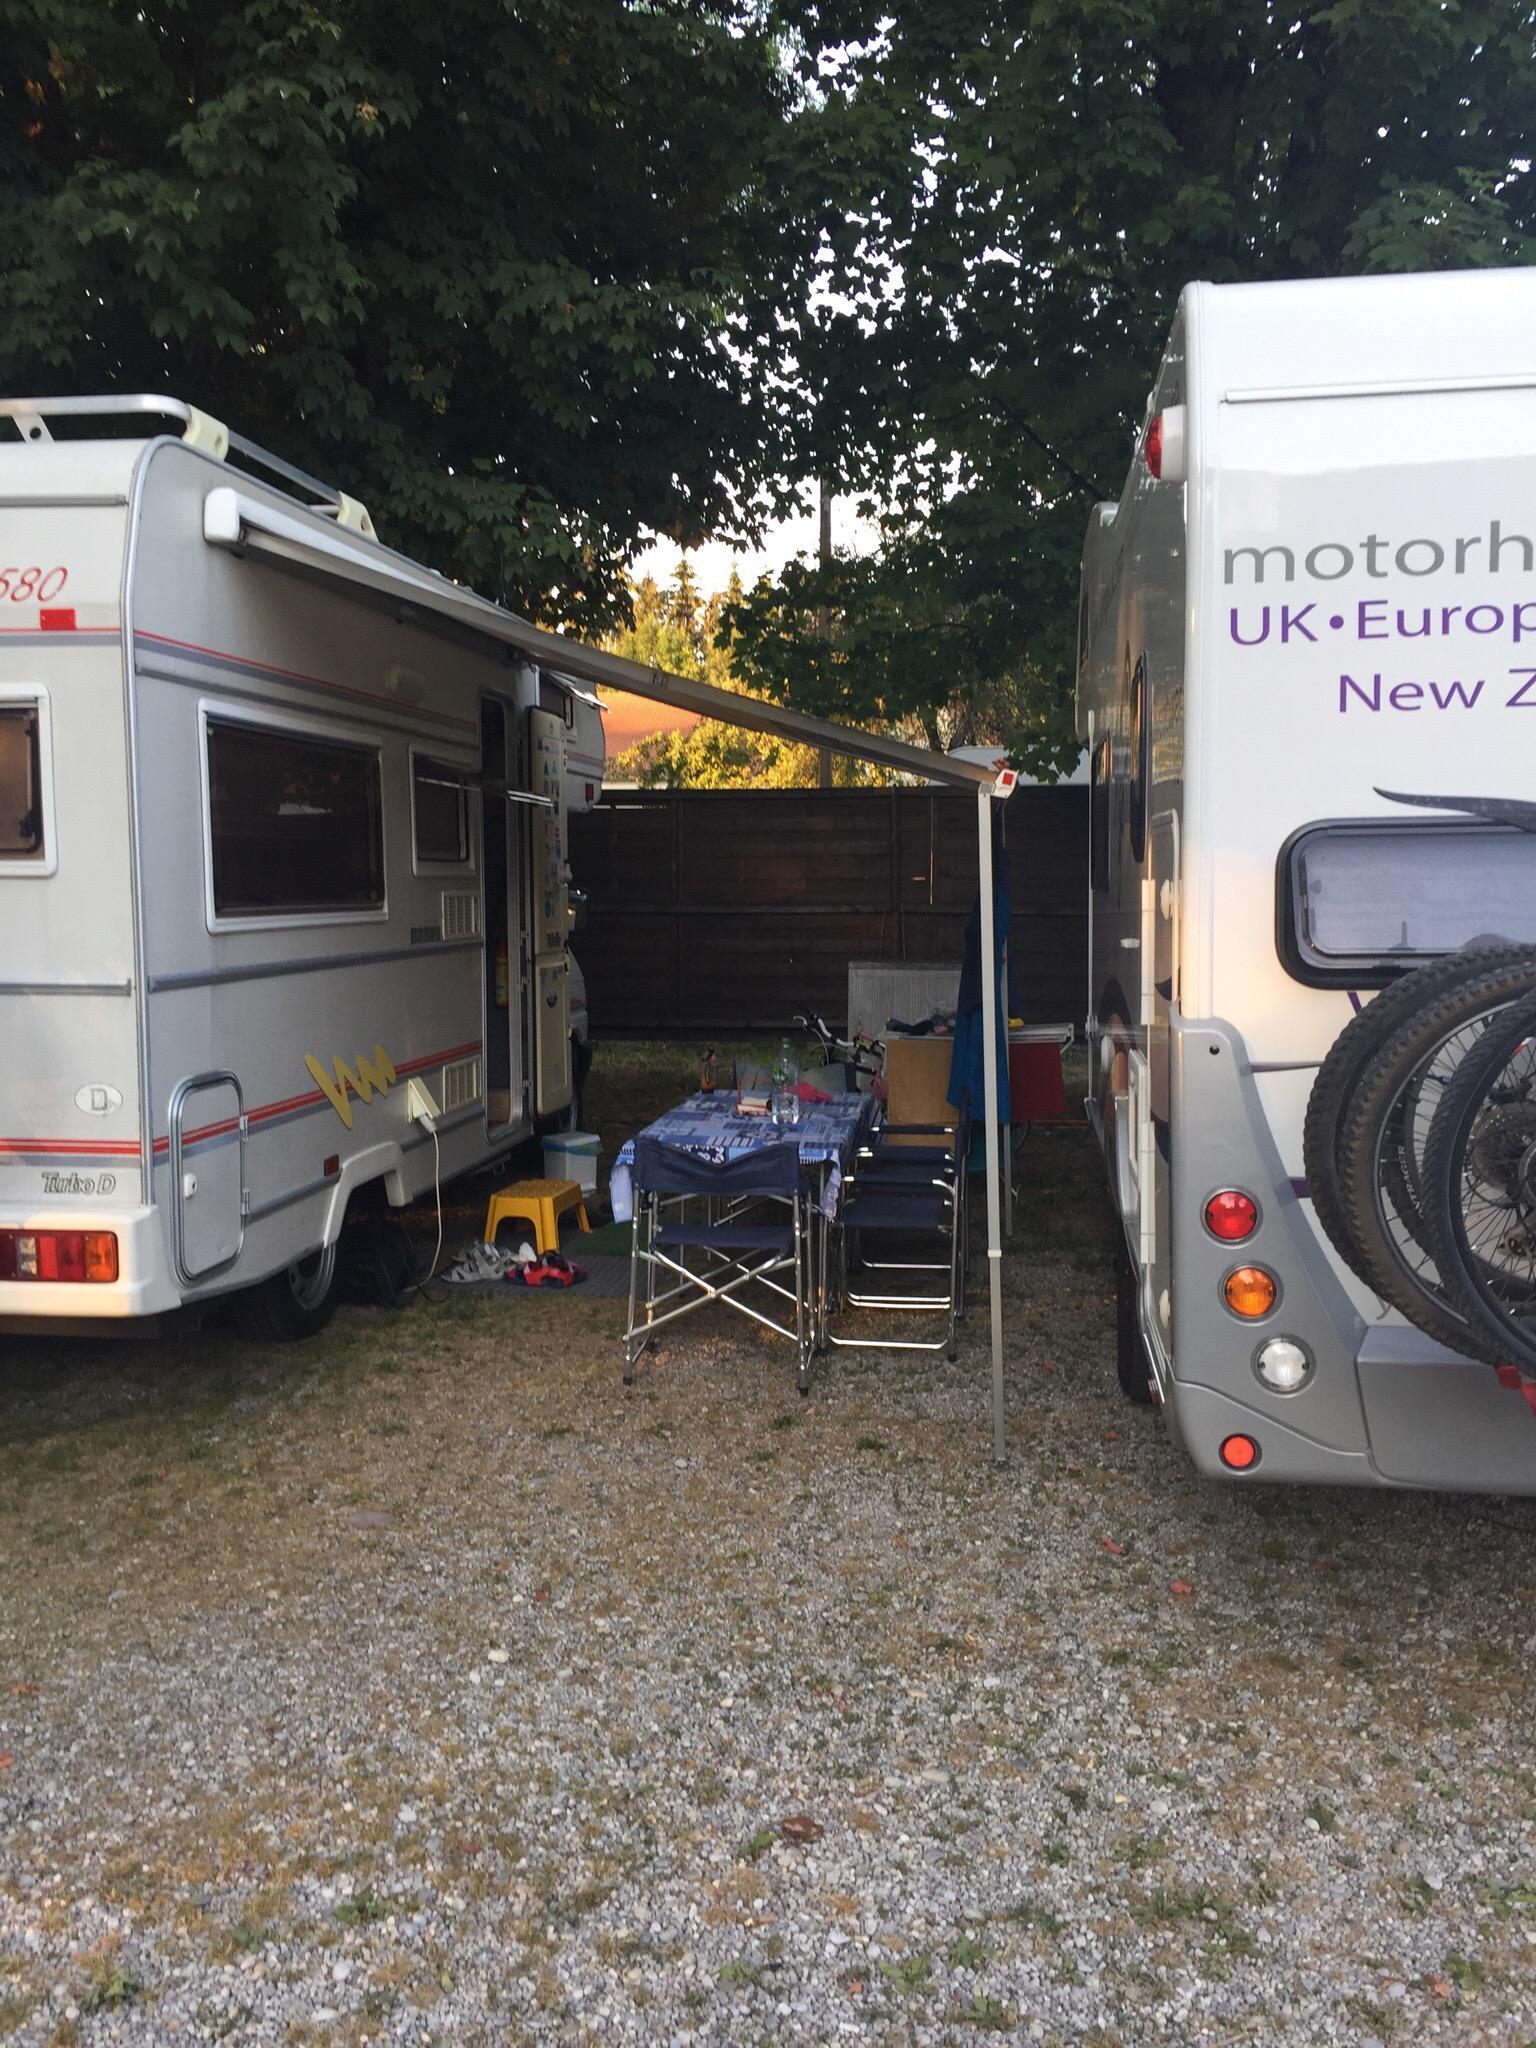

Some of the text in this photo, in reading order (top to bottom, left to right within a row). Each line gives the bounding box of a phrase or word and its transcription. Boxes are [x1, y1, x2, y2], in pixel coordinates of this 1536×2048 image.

[1224, 520, 1533, 584] motorh
[1339, 673, 1486, 712] New
[91, 1088, 108, 1111] D
[41, 1171, 117, 1195] Turbo D
